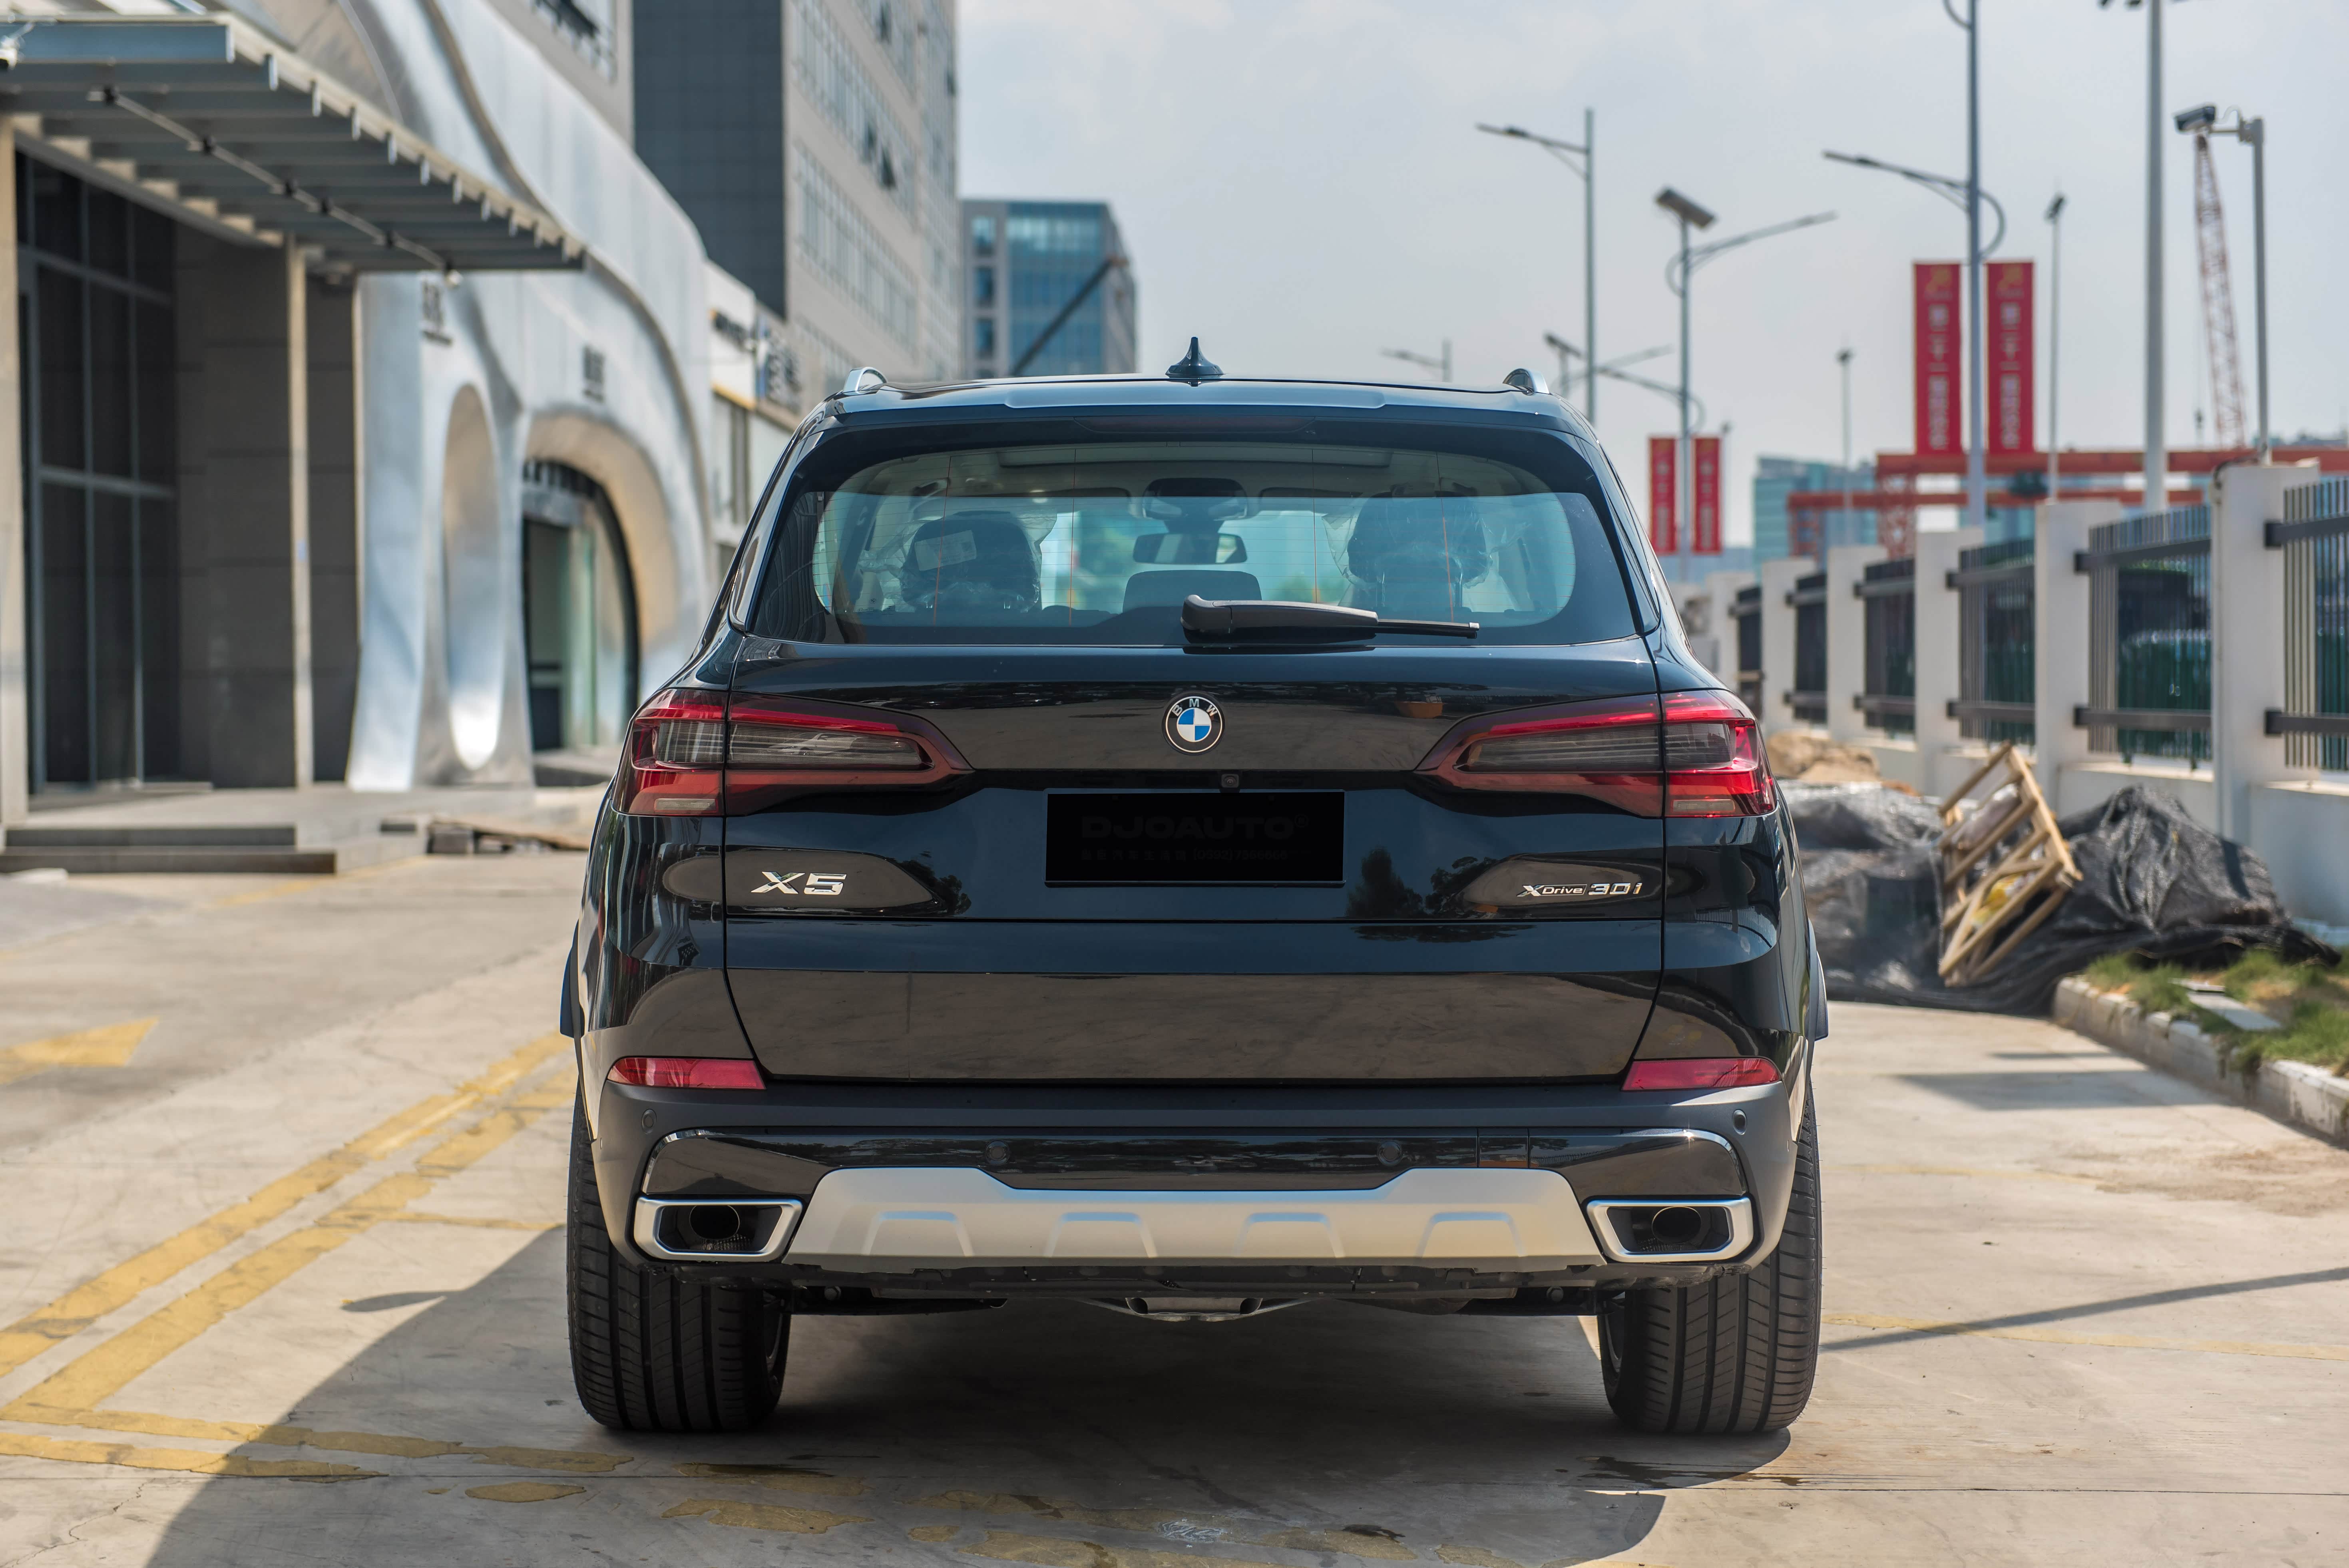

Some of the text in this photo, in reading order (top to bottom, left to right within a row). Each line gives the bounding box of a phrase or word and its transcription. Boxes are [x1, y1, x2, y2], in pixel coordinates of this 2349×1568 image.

[1172, 698, 1218, 716] BMW
[1081, 815, 1294, 839] DJOAUTO
[750, 871, 847, 895] X5
